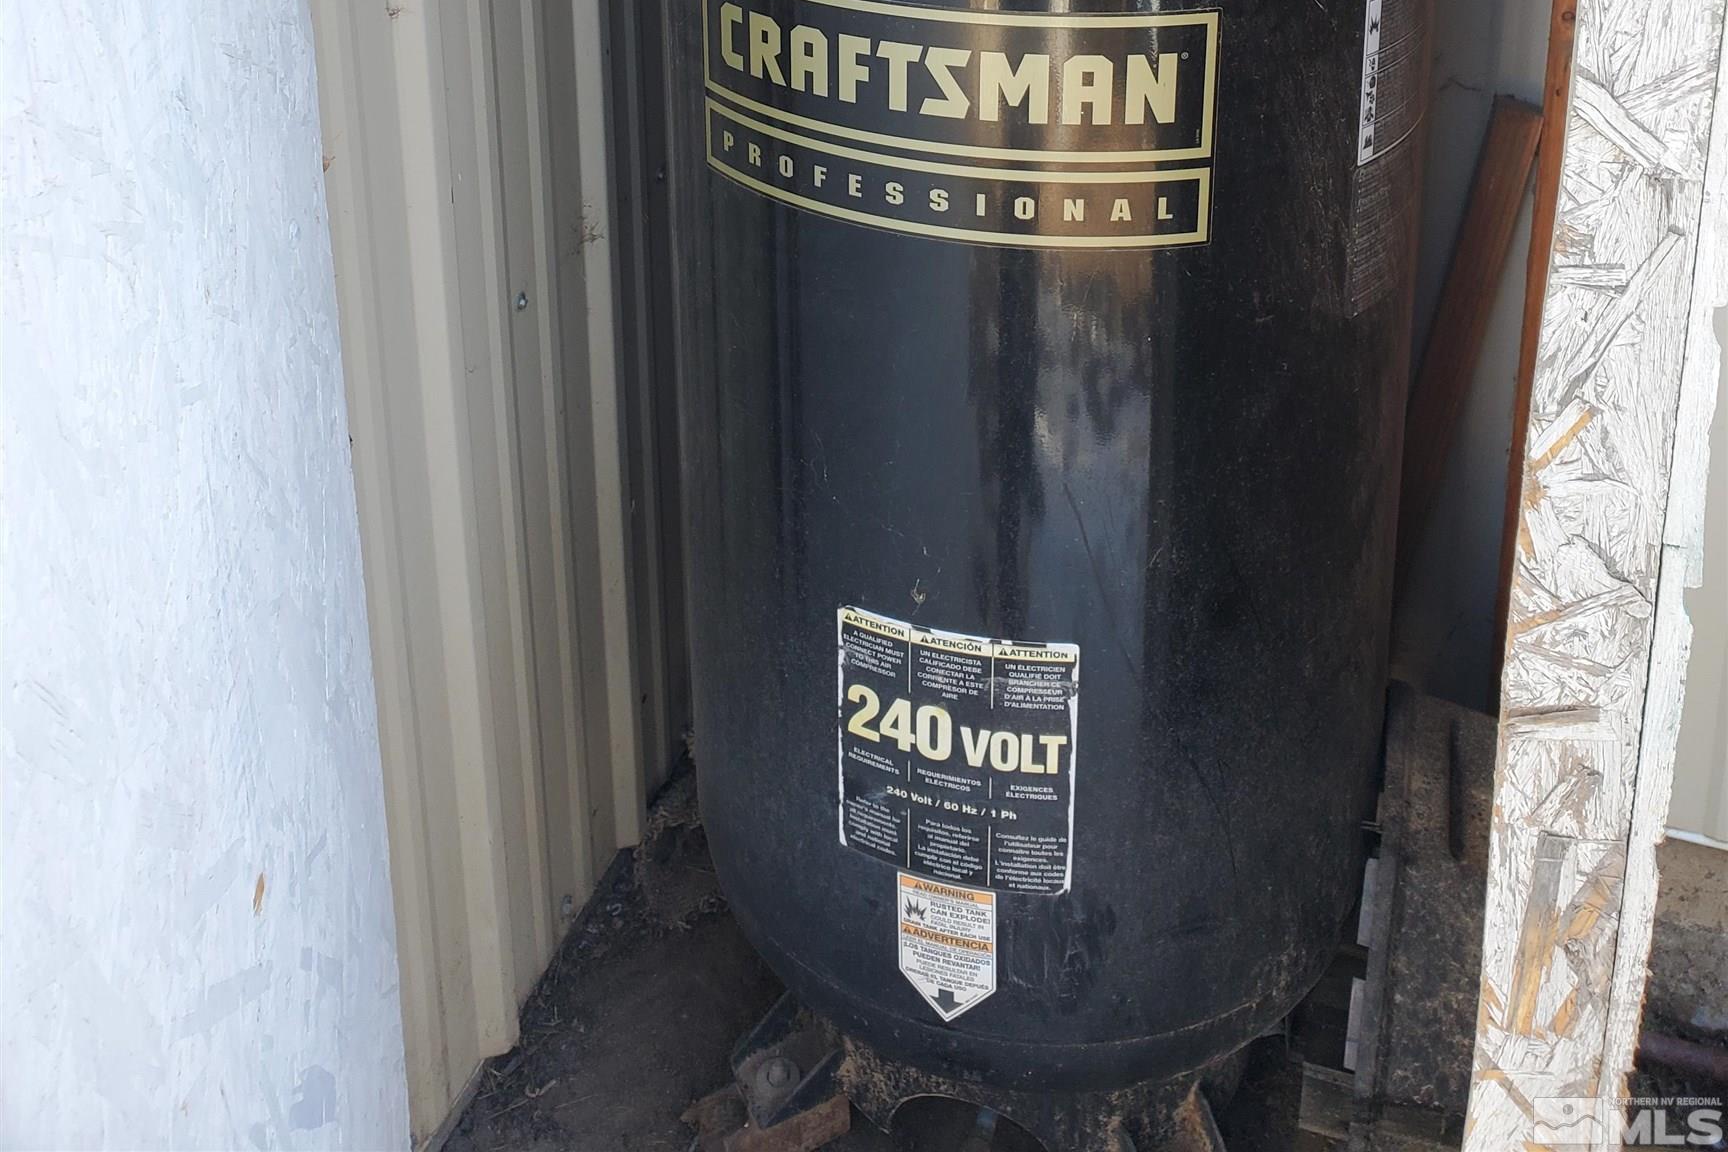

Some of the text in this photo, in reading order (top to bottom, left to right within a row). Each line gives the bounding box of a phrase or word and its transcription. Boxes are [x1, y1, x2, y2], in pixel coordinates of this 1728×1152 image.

[723, 130, 1174, 222] PROFESSIONAL
[853, 616, 904, 637] ATTENTION
[844, 633, 904, 657] ELECTRICIAN MUST
[859, 632, 893, 647] QUALIFIED
[931, 637, 981, 652] ATENCIÓN
[846, 642, 901, 664] CONNECT POWER
[865, 655, 879, 665] THIS
[932, 652, 981, 666] ELECTRICISTA
[1009, 649, 1068, 658] ATTENTION
[851, 658, 896, 678] COMPRESSOR
[919, 657, 961, 670] CALIFICADO
[917, 672, 958, 684] CORRIENTE
[926, 666, 964, 678] CONECTAR
[1007, 687, 1062, 695] COMPRESSEUR
[1004, 702, 1064, 710] D'ALIMENTATION
[848, 684, 1068, 774] 240 VOLT
[848, 751, 899, 775] REQUIREMENTS
[854, 747, 894, 766] ELECTRICAL
[917, 768, 982, 786] REQUERIMIENTOS
[1010, 785, 1053, 793] EXIGENCES
[886, 785, 1017, 820] 240 Volt / 60 Hz / 1 Ph
[922, 883, 975, 900] WARNING
[931, 901, 987, 917] RUSTED TANK
[931, 908, 947, 916] CAN
[913, 929, 989, 951] ADVERTENCIA
[913, 951, 940, 963] PUEDEN
[920, 945, 952, 958] TANQUES
[954, 955, 990, 966] OXIDADOS
